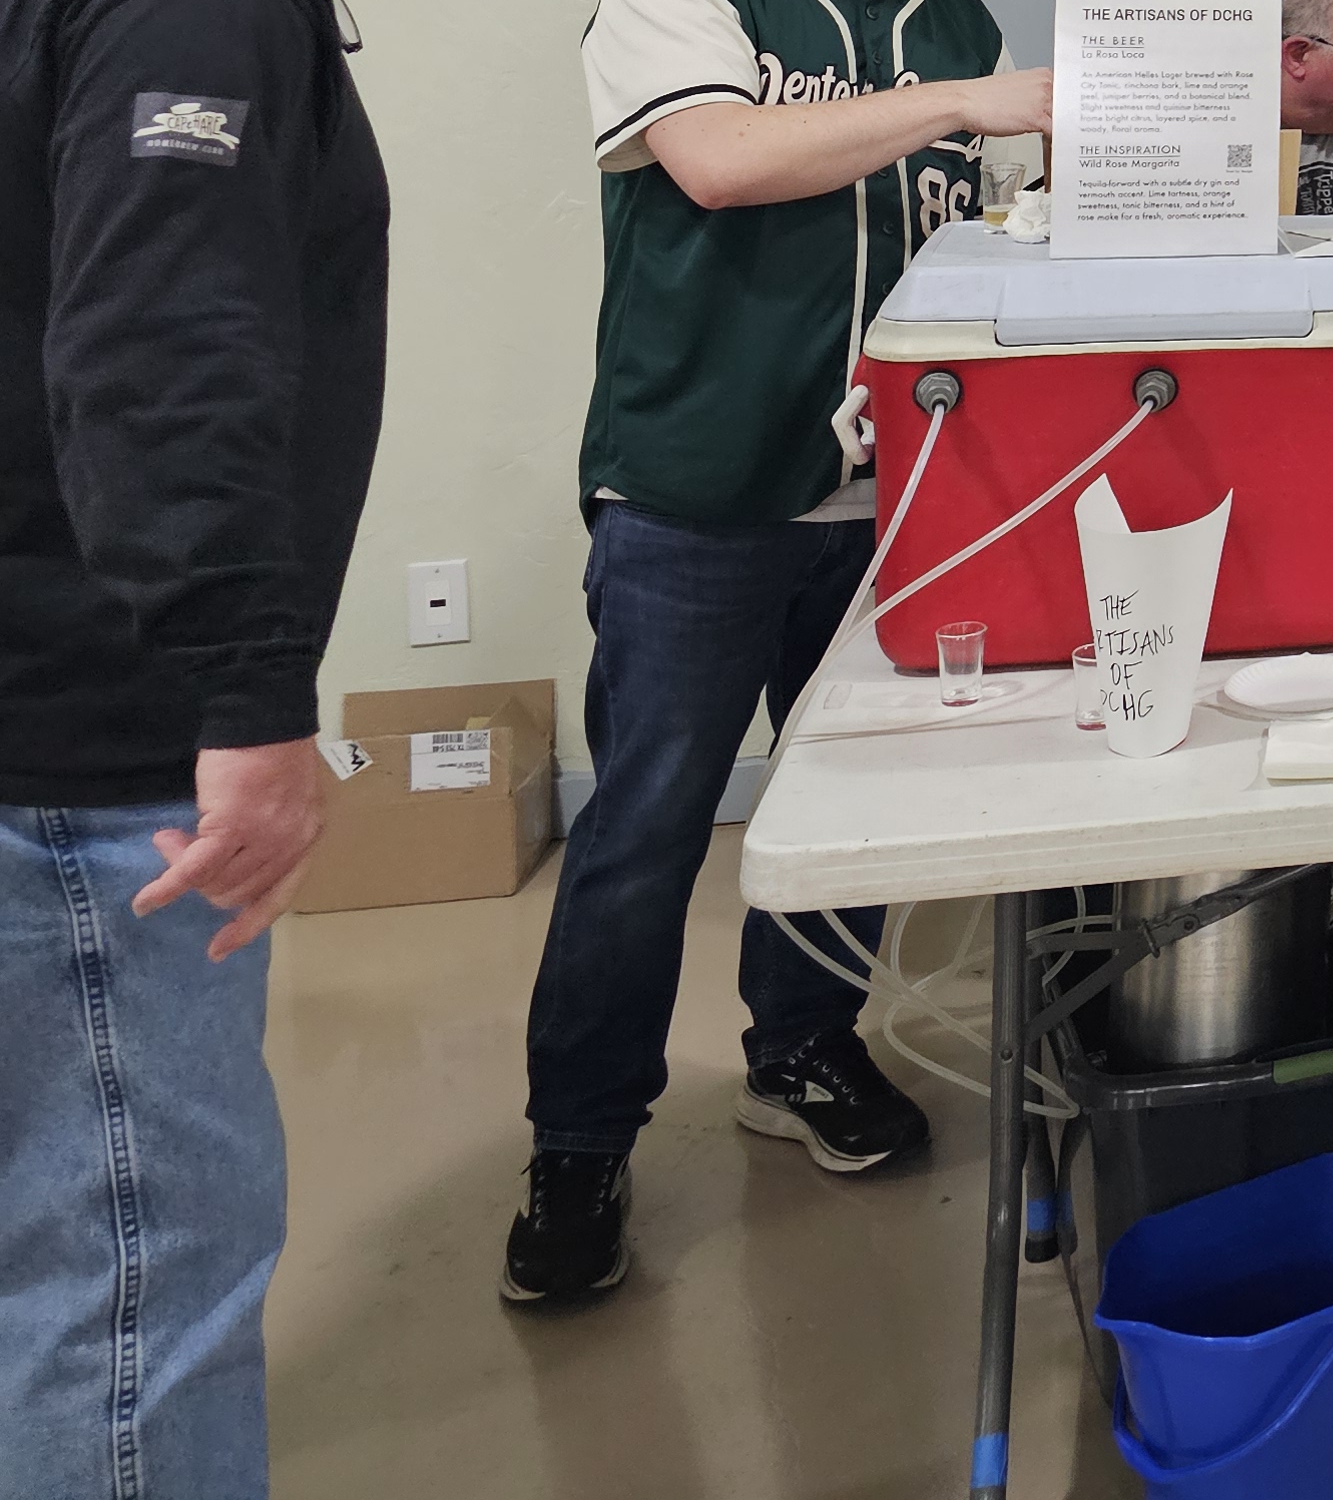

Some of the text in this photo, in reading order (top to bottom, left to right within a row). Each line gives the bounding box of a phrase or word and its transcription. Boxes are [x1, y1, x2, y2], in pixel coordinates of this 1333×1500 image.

[1083, 9, 1253, 21] THE ARTISANS OF DCHG
[1082, 36, 1145, 45] THE BEER
[1082, 50, 1145, 59] La Rosa Loca
[1161, 71, 1183, 80] Lager
[1081, 82, 1096, 91] City
[1162, 82, 1182, 90] bark,
[1132, 93, 1161, 101] berries,
[1228, 92, 1252, 100] blend.
[1105, 103, 1143, 111] sweetness
[1145, 103, 1161, 111] and
[1193, 103, 1231, 111] bitterness
[1105, 115, 1129, 123] bright
[1155, 115, 1186, 123] layered
[1080, 145, 1181, 155] THE INSPIRATION
[1079, 160, 1180, 169] Wild Rose Margarita
[1078, 180, 1140, 189] Tequila-forward
[1194, 179, 1208, 188] dry
[1210, 180, 1222, 188] gin
[1168, 190, 1200, 198] tartness,
[1203, 191, 1231, 199] orange
[1078, 202, 1120, 210] sweetness,
[1122, 201, 1141, 209] tonic
[1143, 201, 1182, 209] bitterness,
[1210, 200, 1225, 208] hint
[1142, 212, 1164, 221] fresh,
[1167, 212, 1200, 220] aromatic
[1203, 212, 1247, 221] experience.
[1099, 589, 1139, 620] THE
[1096, 624, 1174, 656] RTISANS
[1110, 661, 1142, 690] OF
